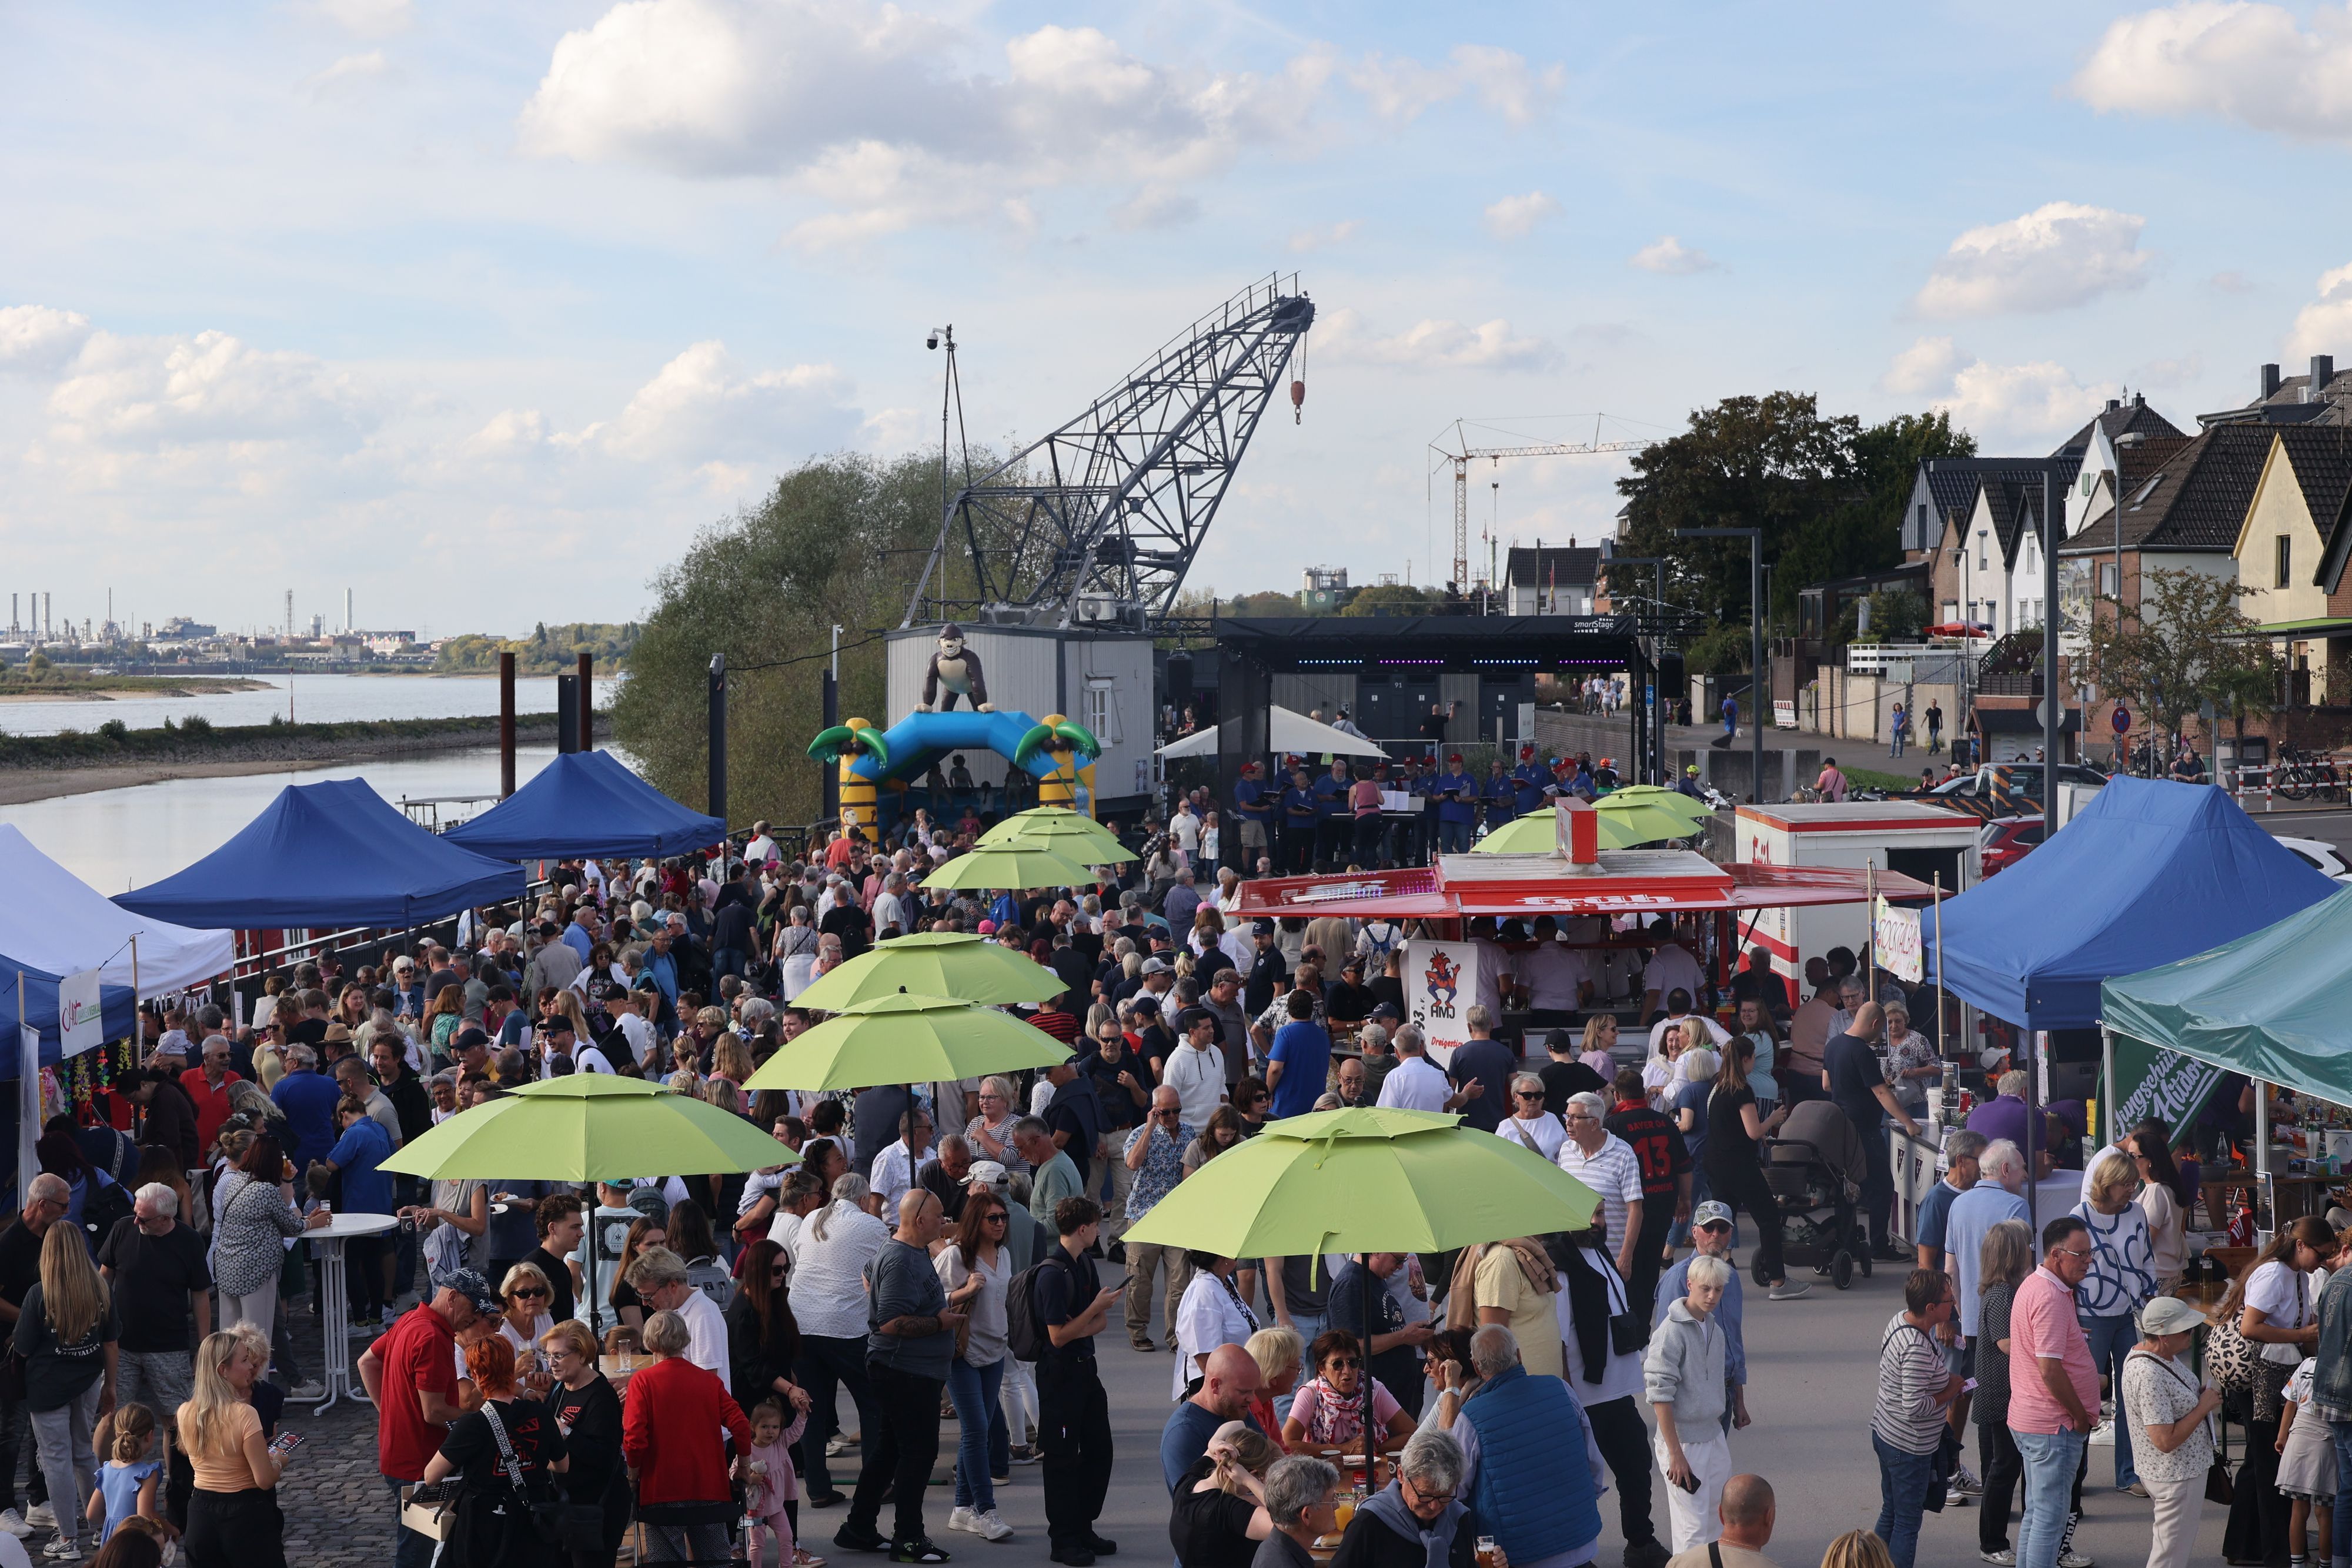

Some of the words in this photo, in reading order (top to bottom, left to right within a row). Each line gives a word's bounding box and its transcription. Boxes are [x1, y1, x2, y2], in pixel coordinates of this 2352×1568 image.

[1574, 620, 1613, 629] smartStage
[1626, 1121, 1653, 1132] BAYER
[1633, 1135, 1671, 1179] 13
[78, 1342, 100, 1356] VALLEY
